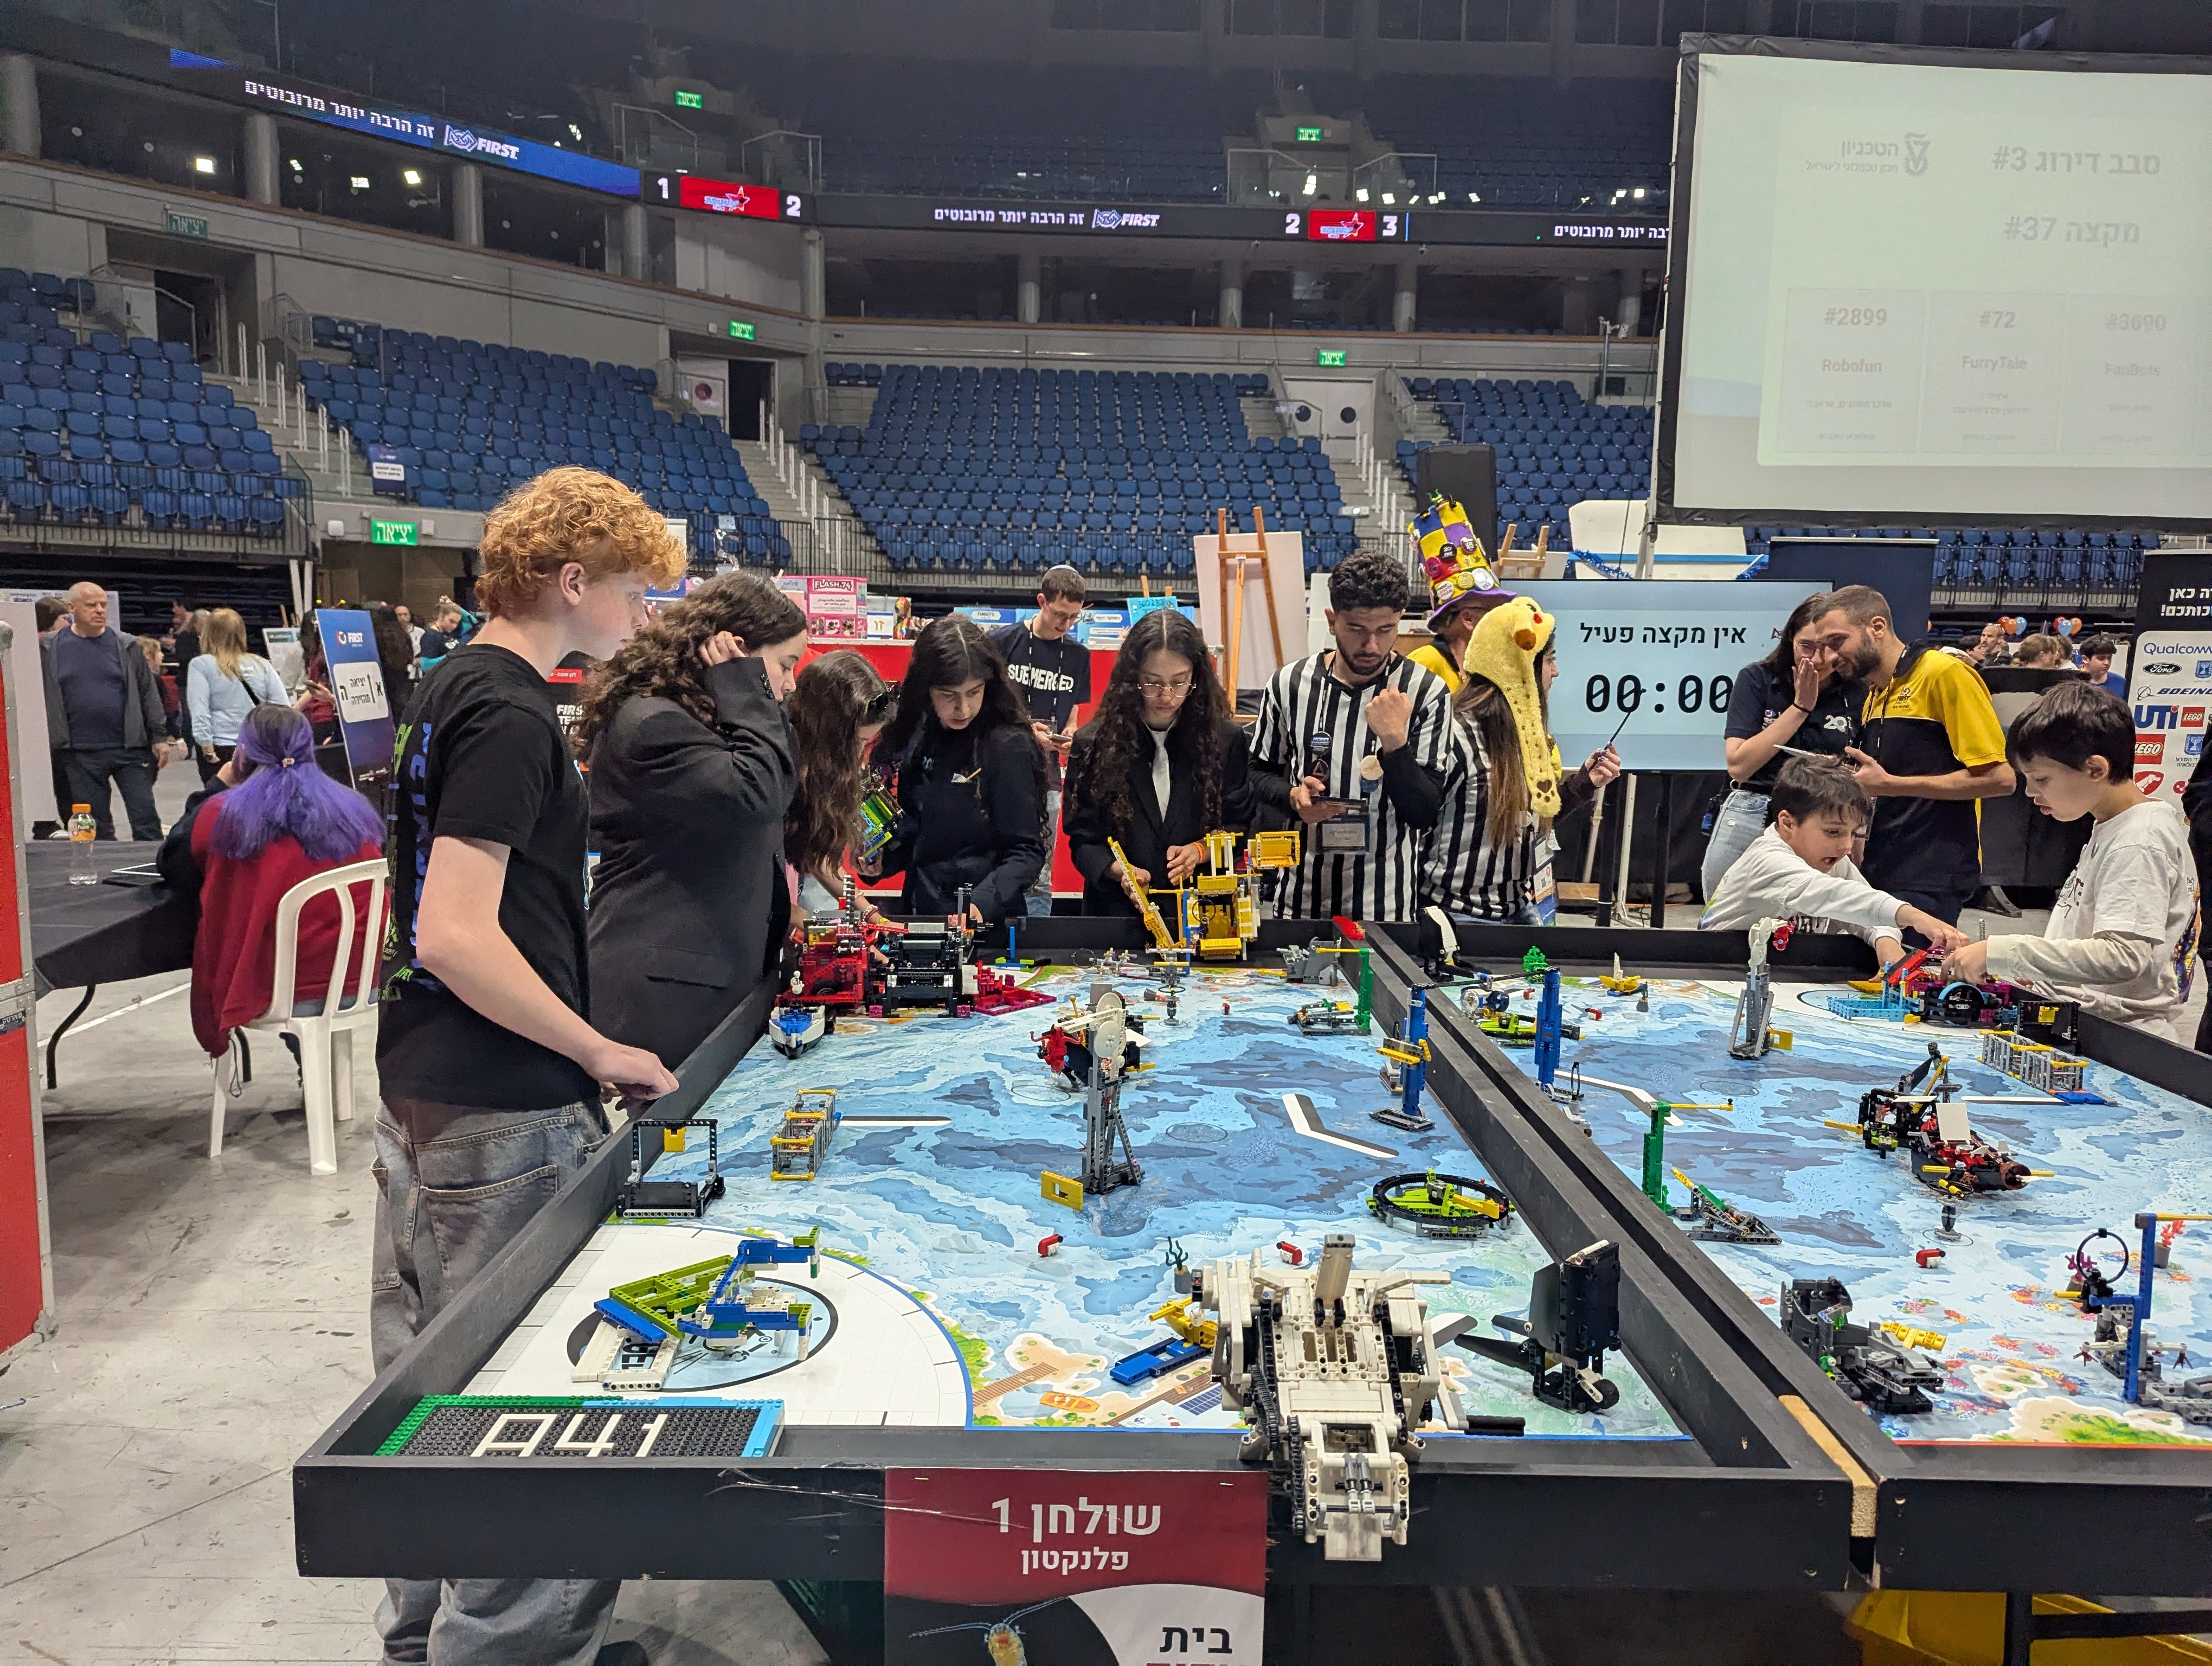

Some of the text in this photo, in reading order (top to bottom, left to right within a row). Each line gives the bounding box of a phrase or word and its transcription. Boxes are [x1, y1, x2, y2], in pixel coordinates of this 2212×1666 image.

[678, 93, 699, 106] יציאה
[245, 81, 519, 159] FIRST זה הרבה יותר מרובוטים
[1298, 129, 1319, 140] יציאה
[1841, 140, 1899, 158] הטכניון
[1992, 146, 2160, 176] סבב דירוג #3
[658, 177, 668, 199] 1
[786, 195, 801, 217] 2
[171, 215, 206, 235] יציאה
[935, 209, 1160, 227] FIRST זה הרבה יותר מרובוטים
[1285, 213, 1300, 234] 2
[1382, 215, 1398, 236] 3
[1554, 225, 1613, 238] מרובוטים
[1617, 227, 1645, 239] יותר
[2004, 216, 2140, 249] מקצה #37
[1824, 307, 1887, 326] #2899
[1979, 311, 2016, 329] #72
[732, 323, 753, 339] יציאה
[1321, 353, 1342, 364] יציאה
[1822, 358, 1882, 373] Robofun
[1962, 355, 2027, 372] FurryTale
[377, 523, 412, 542] יציאה
[2170, 588, 2195, 601] כאן
[1580, 623, 1746, 649] אין מקצה פעיל
[2150, 662, 2175, 673] Ford
[350, 677, 365, 688] יציאה
[1007, 663, 1074, 691] SUBMERGED
[339, 684, 348, 701] ה
[1586, 674, 1733, 713] 00:00
[556, 704, 586, 715] FIRS
[992, 1497, 1161, 1543] שולחן 1
[1021, 1547, 1129, 1575] פלנקטון
[1159, 1626, 1233, 1654] בית
